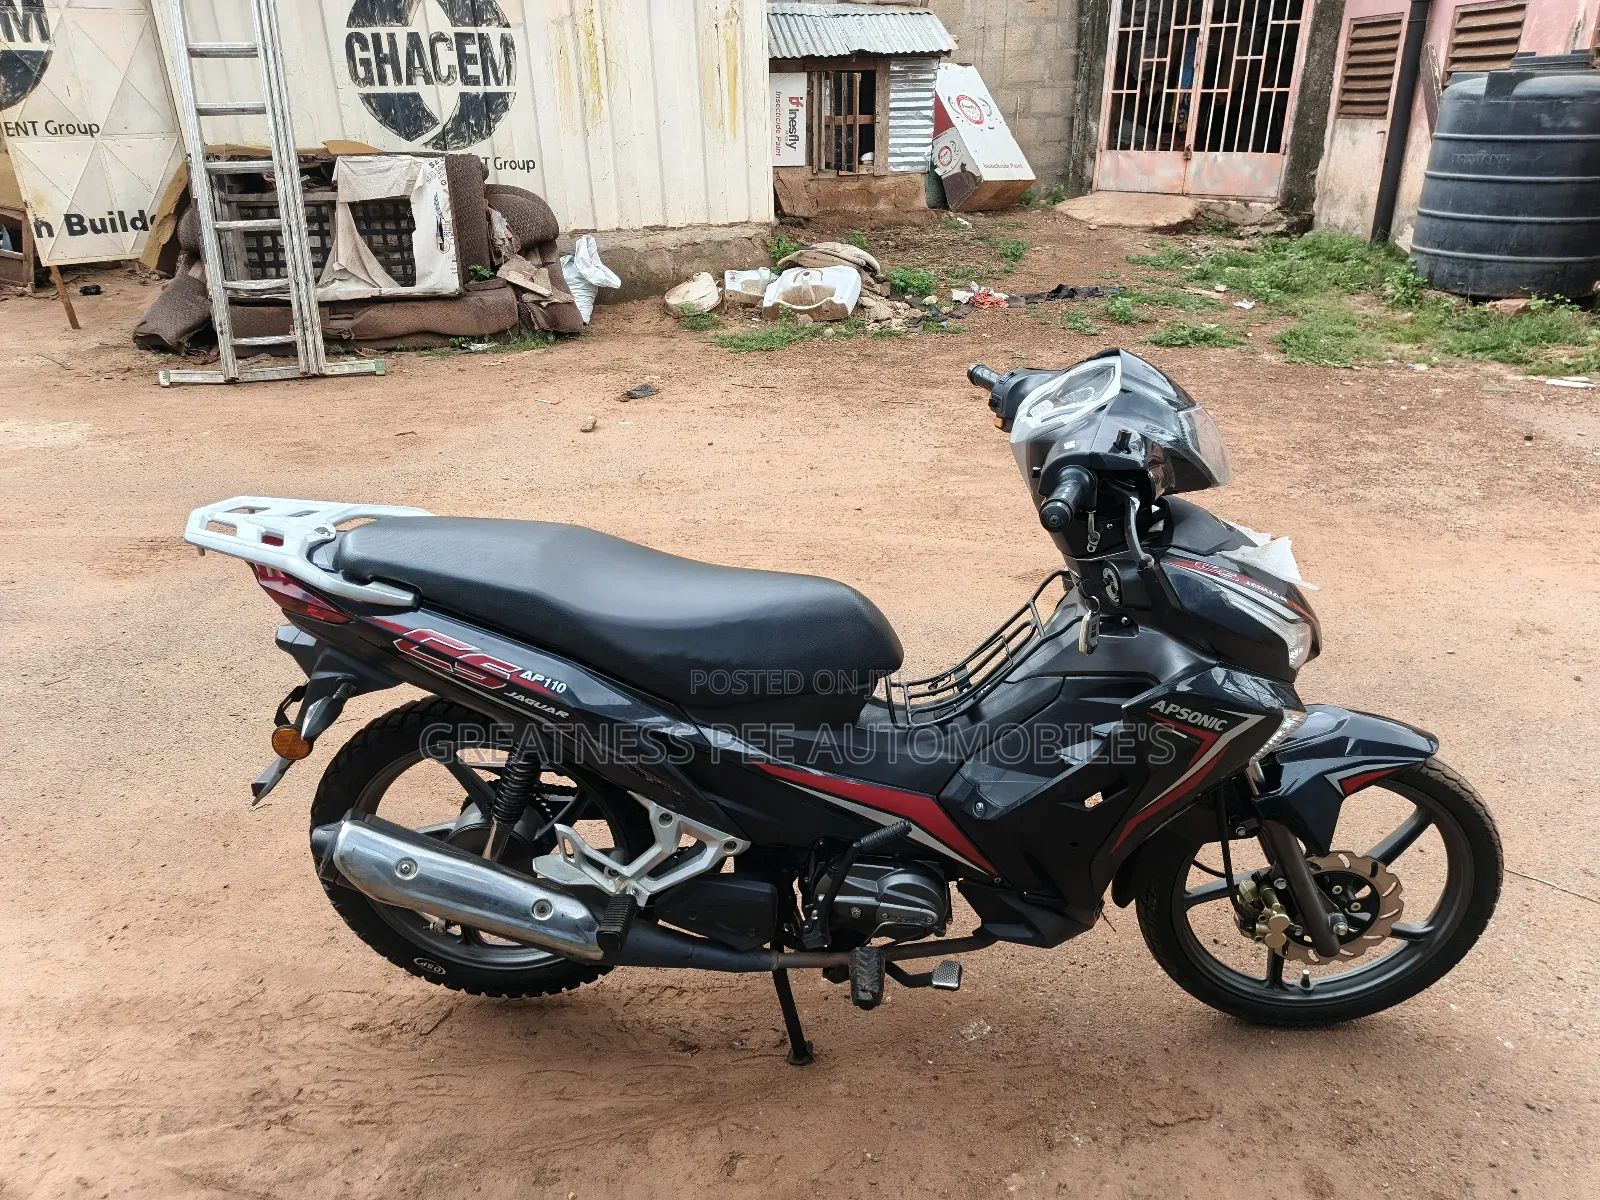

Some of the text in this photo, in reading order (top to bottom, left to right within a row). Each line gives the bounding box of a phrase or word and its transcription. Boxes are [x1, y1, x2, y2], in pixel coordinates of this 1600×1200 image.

[345, 31, 517, 88] GHACEM
[0, 120, 101, 138] ENT Group
[785, 108, 800, 150] Inesfly
[494, 157, 536, 173] Group
[64, 209, 156, 237] Build
[518, 669, 567, 694] AP110
[503, 691, 570, 719] JAGUAR
[1149, 699, 1228, 731] APSONIC
